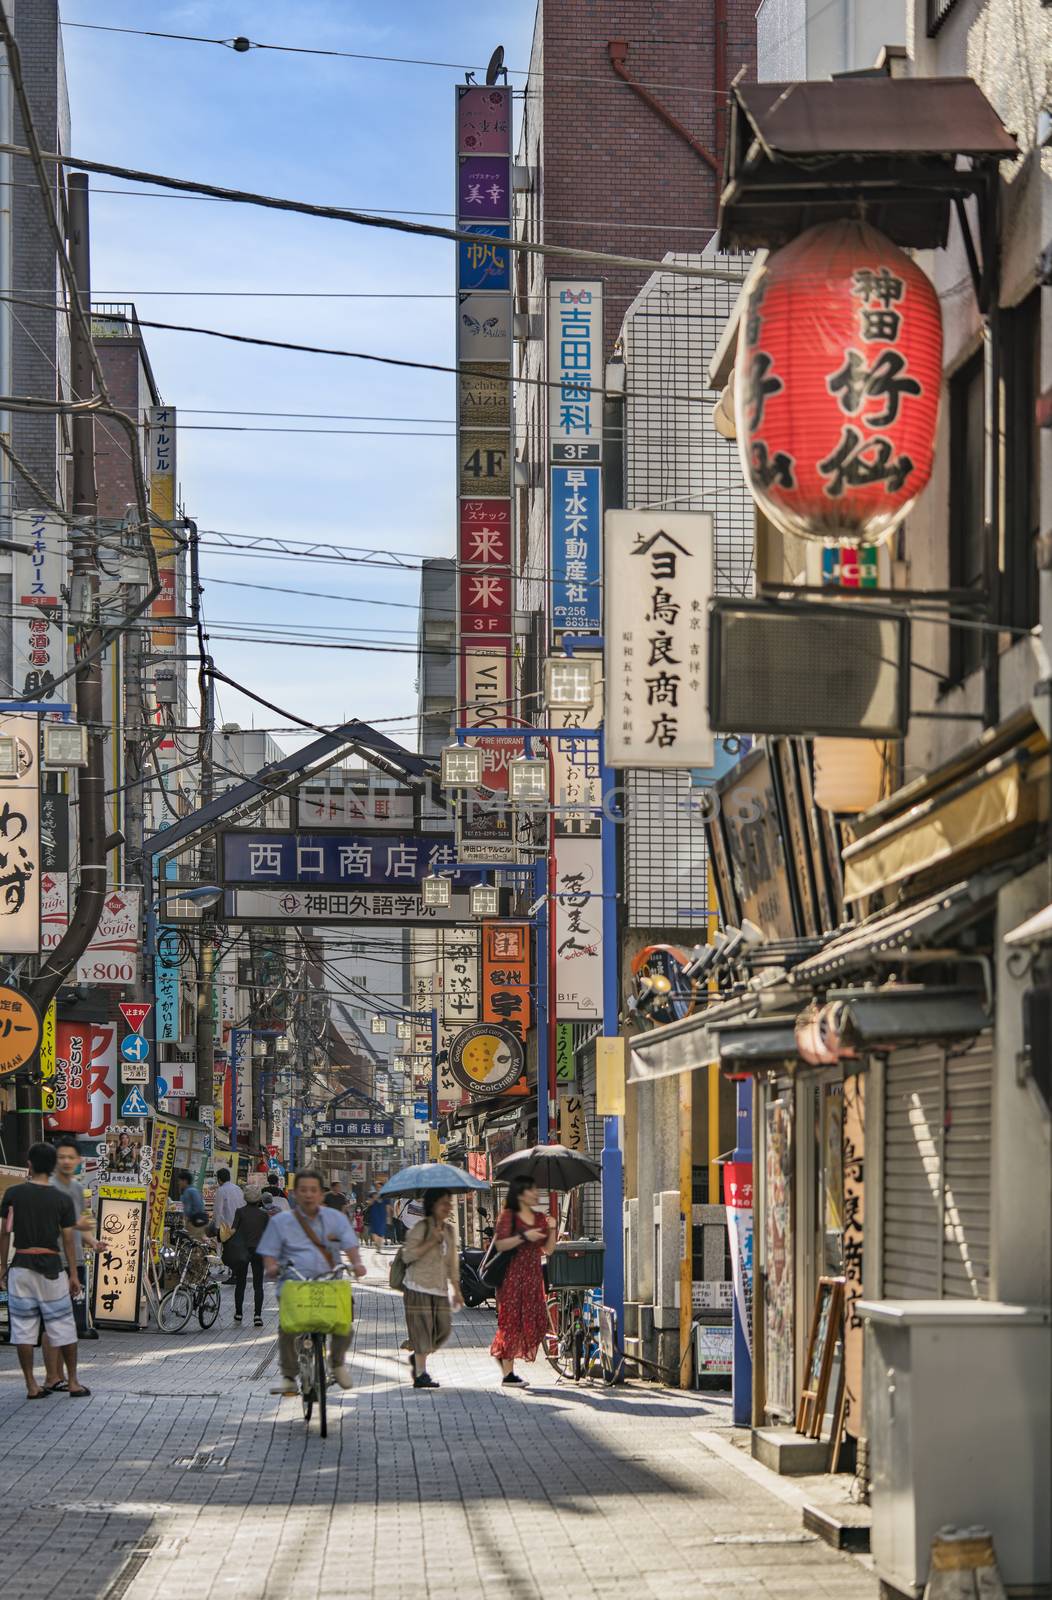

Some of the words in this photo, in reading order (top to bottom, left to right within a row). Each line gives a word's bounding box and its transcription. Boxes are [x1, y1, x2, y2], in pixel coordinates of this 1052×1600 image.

[464, 183, 505, 205] 美幸
[851, 267, 905, 343] 神田
[560, 307, 592, 436] 吉田歯科
[463, 449, 506, 478] 4F
[564, 446, 588, 459] 3F
[564, 470, 588, 603] 早水不動産社
[31, 515, 46, 595] アイキリース
[823, 564, 877, 578] JCB
[31, 597, 48, 605] 3F
[568, 606, 586, 616] 256
[50, 611, 62, 620] 2F
[474, 619, 498, 630] 3F
[31, 619, 48, 665] 居酒屋
[249, 843, 461, 879] 西口商店街
[304, 893, 436, 916] 神田外語学院
[70, 1035, 83, 1088] とりかわ
[320, 1123, 385, 1133] 西口商店街
[101, 1251, 122, 1313] わいず
